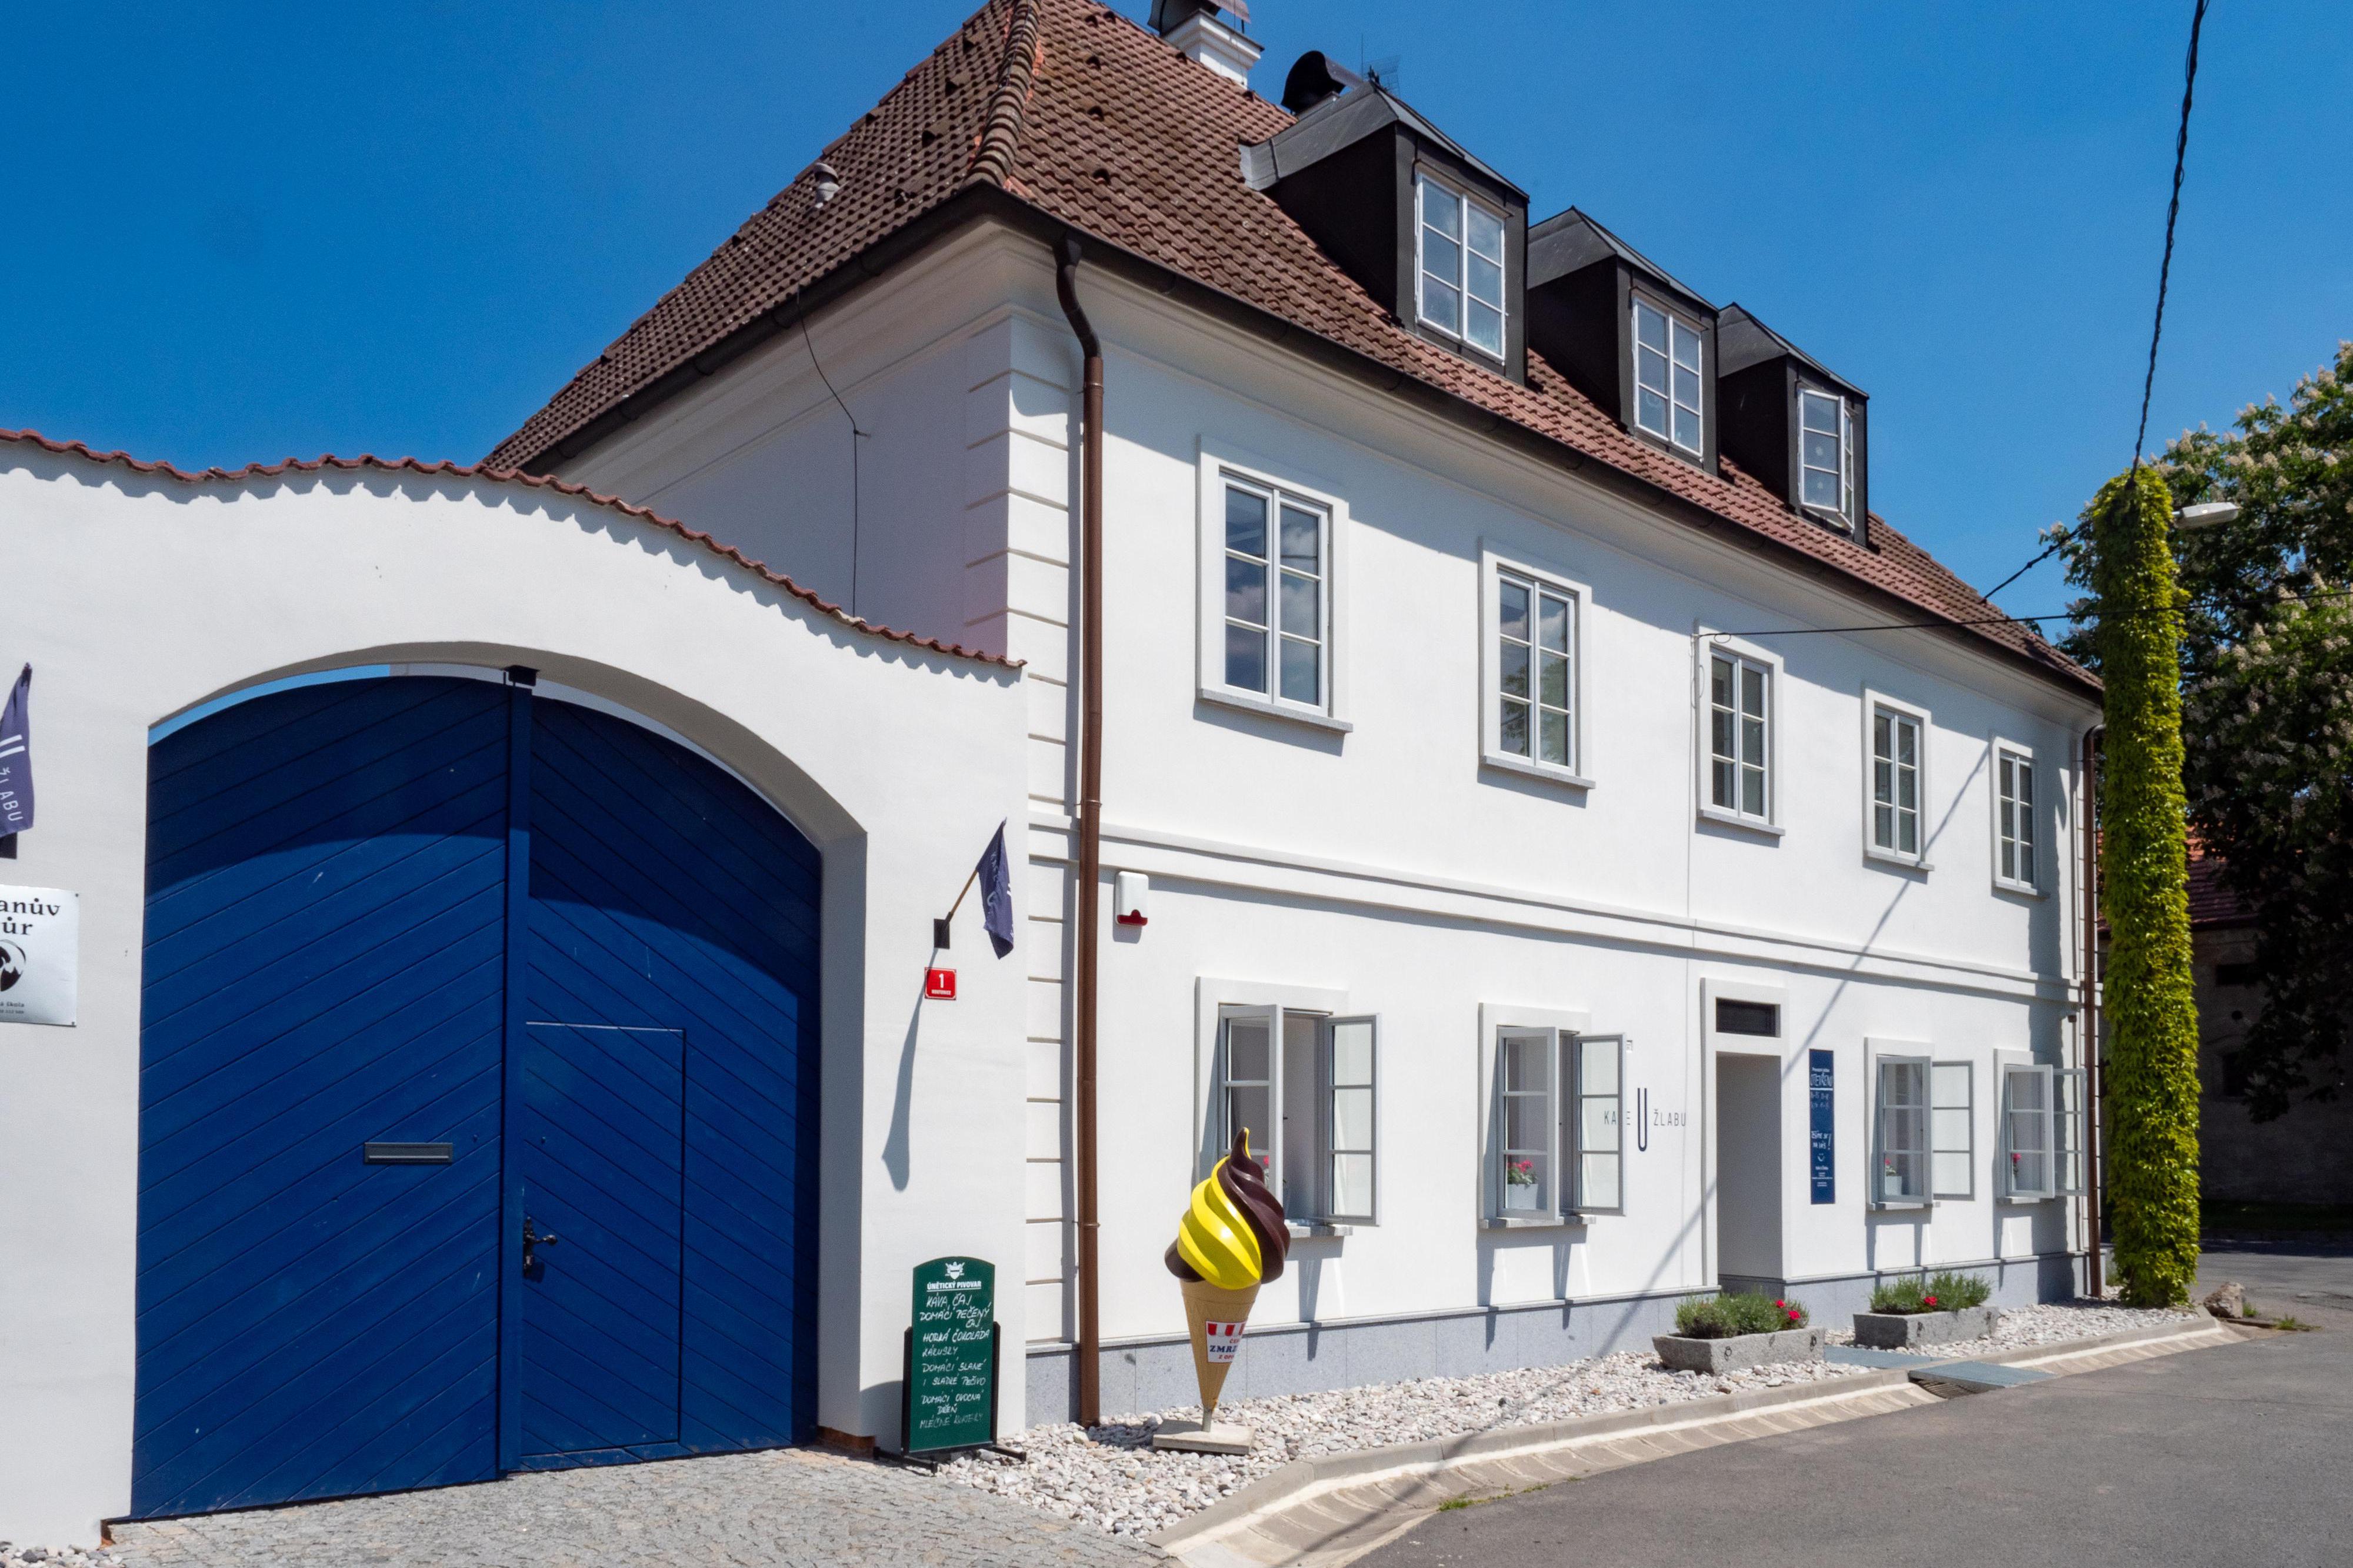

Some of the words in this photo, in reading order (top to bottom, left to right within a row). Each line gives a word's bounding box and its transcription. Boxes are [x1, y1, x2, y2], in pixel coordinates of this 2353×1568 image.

[939, 973, 944, 988] 1
[1604, 1110, 1631, 1125] KAE
[1637, 1087, 1647, 1152] U
[1654, 1109, 1687, 1127] ŽLABU
[927, 1281, 956, 1290] ÚNĚTICKÝ
[952, 1292, 972, 1306] ČAJ
